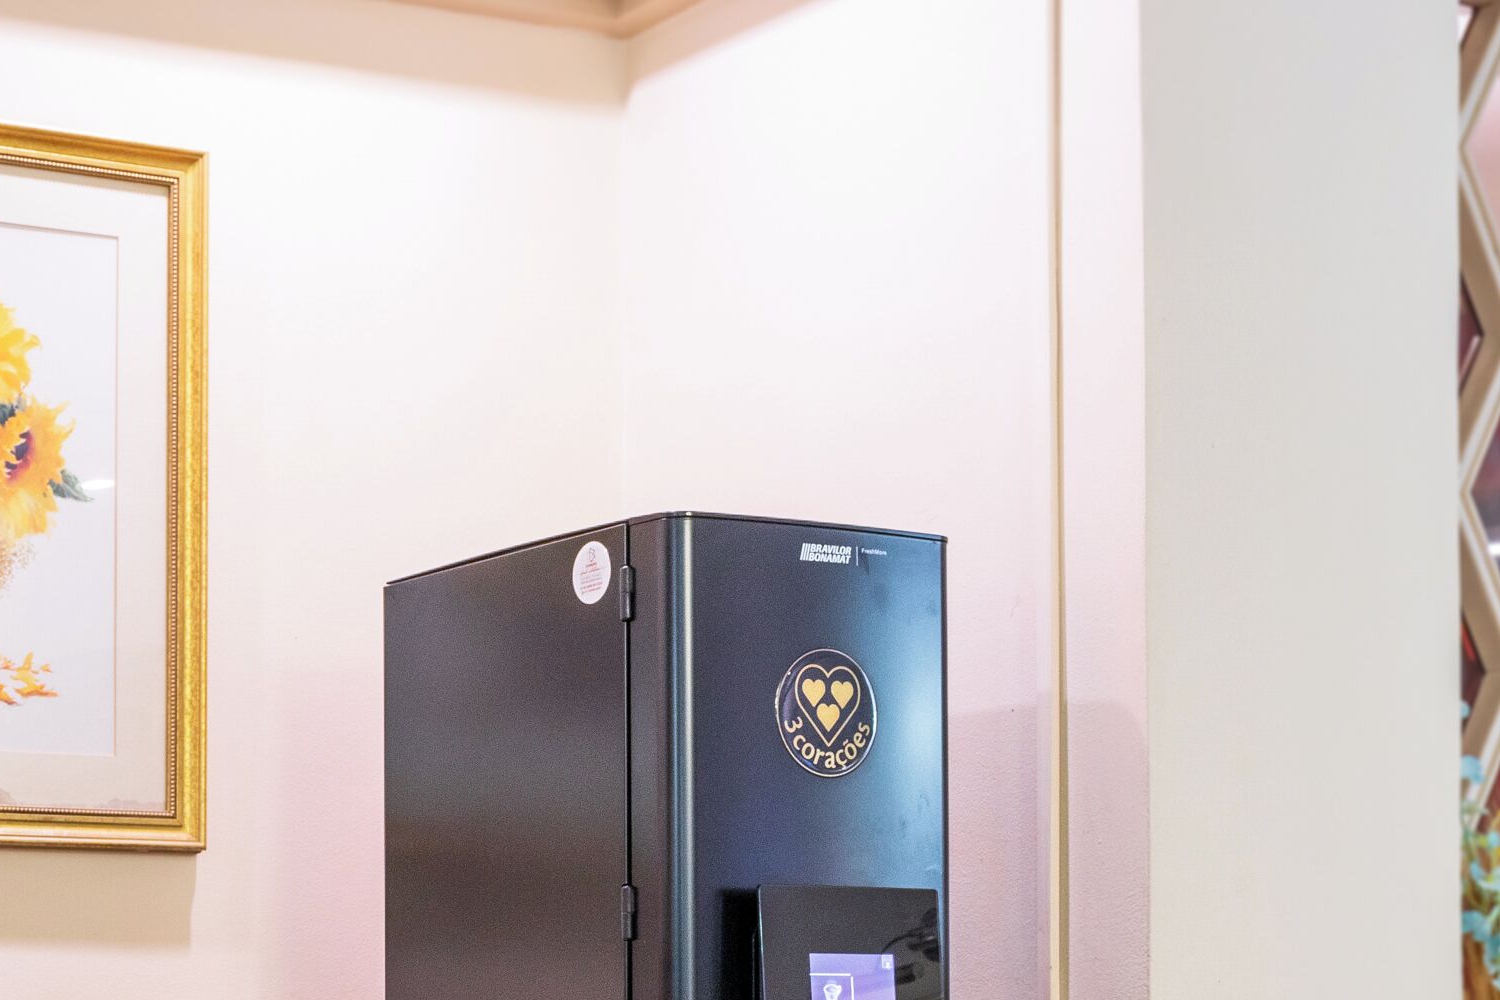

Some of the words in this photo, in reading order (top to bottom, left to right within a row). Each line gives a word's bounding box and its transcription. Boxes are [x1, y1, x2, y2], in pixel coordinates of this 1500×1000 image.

[810, 543, 852, 555] BRAVILOR
[808, 552, 852, 564] BONAMAT
[784, 716, 803, 733] 3
[793, 722, 871, 770] corações
